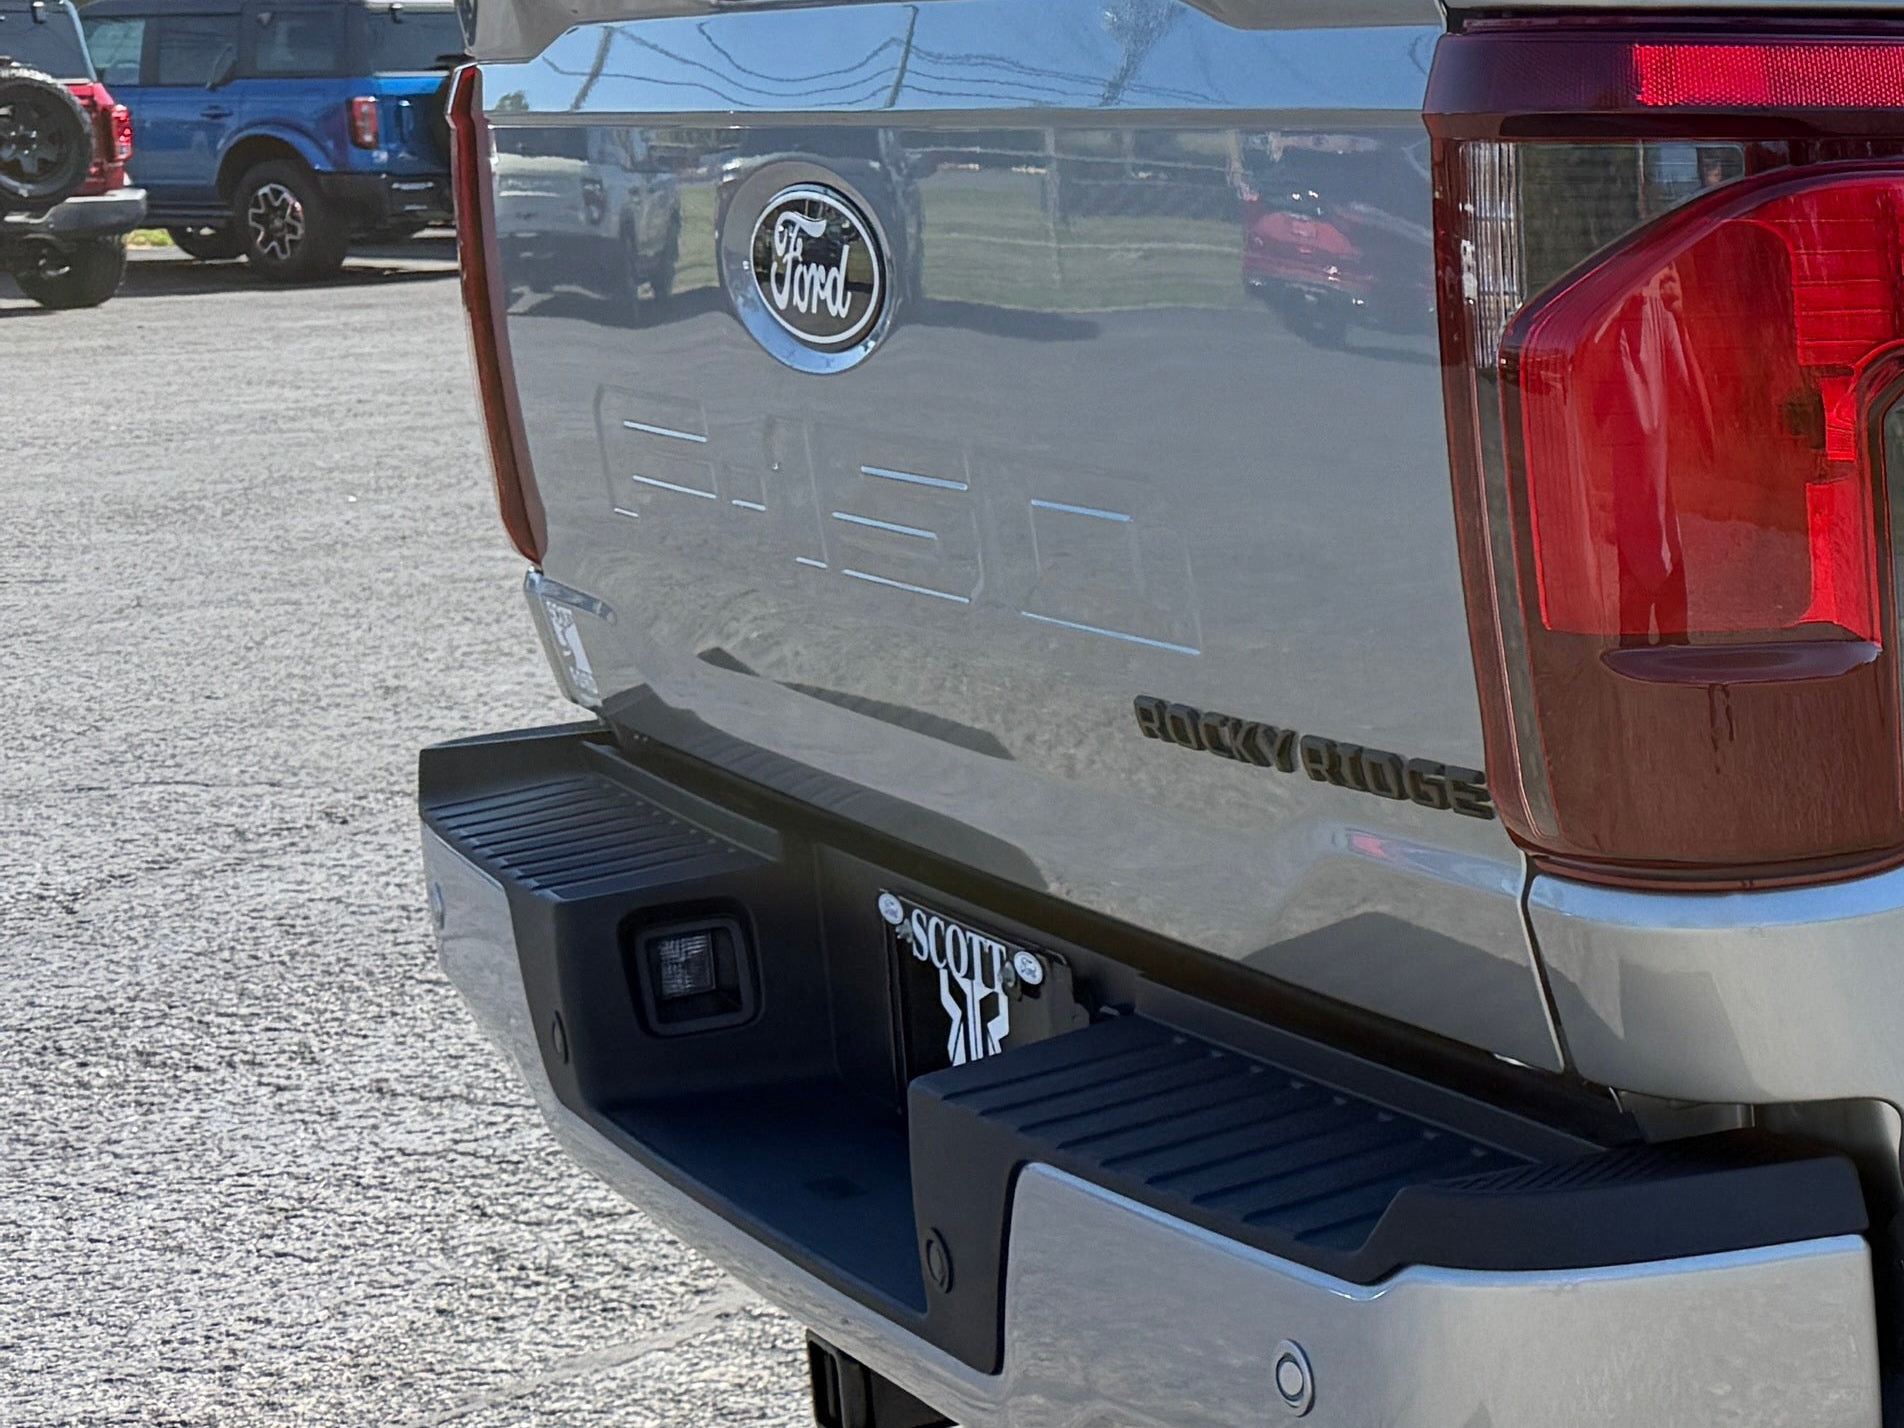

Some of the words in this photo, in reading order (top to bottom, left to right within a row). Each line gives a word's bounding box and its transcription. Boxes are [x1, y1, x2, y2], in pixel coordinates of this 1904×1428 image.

[770, 211, 851, 318] Ford
[1134, 695, 1298, 774] ROCKY
[1300, 734, 1496, 821] RIDGE
[911, 908, 1007, 992] SCOTT
